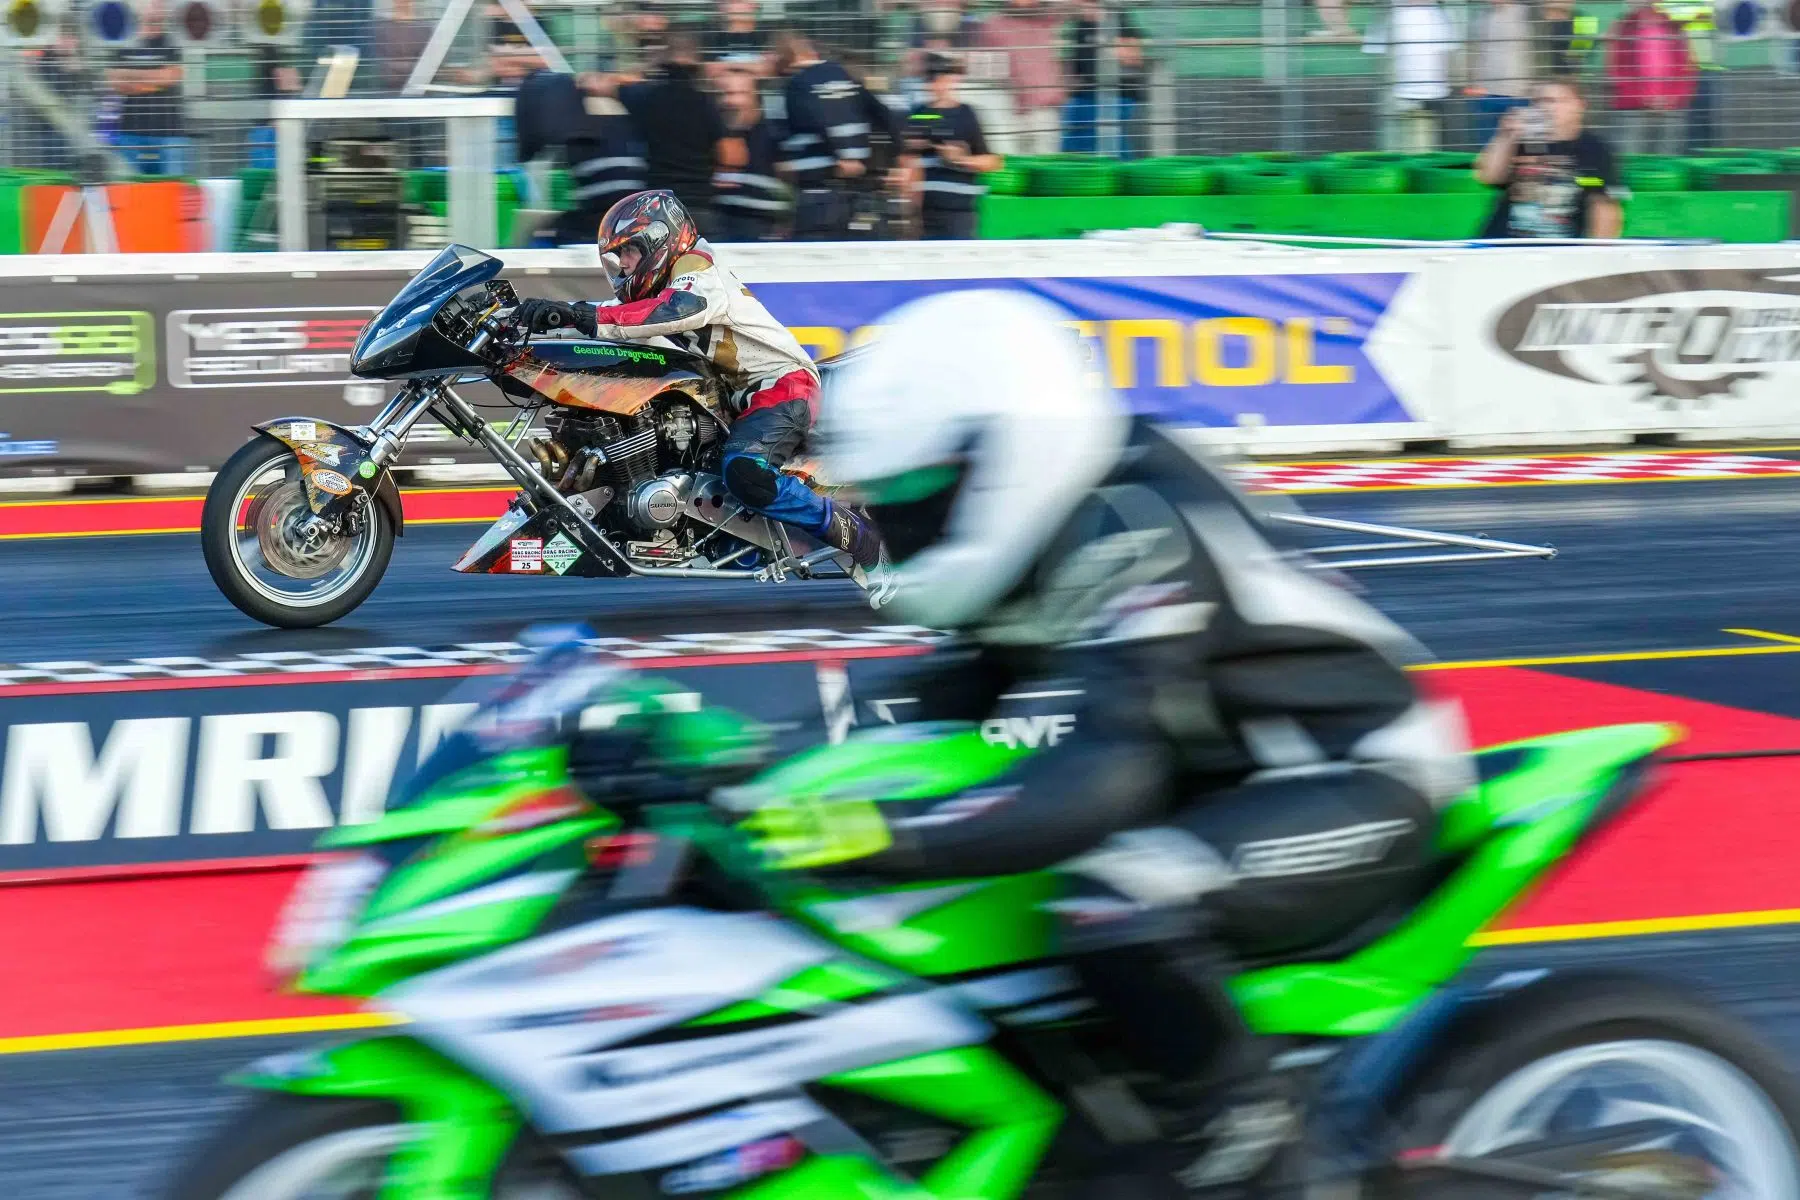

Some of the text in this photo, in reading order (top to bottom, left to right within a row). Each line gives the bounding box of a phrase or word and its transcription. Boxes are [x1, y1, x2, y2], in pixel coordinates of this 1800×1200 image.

[616, 347, 666, 365] Dragracing
[521, 562, 531, 570] 25
[554, 561, 566, 569] 24
